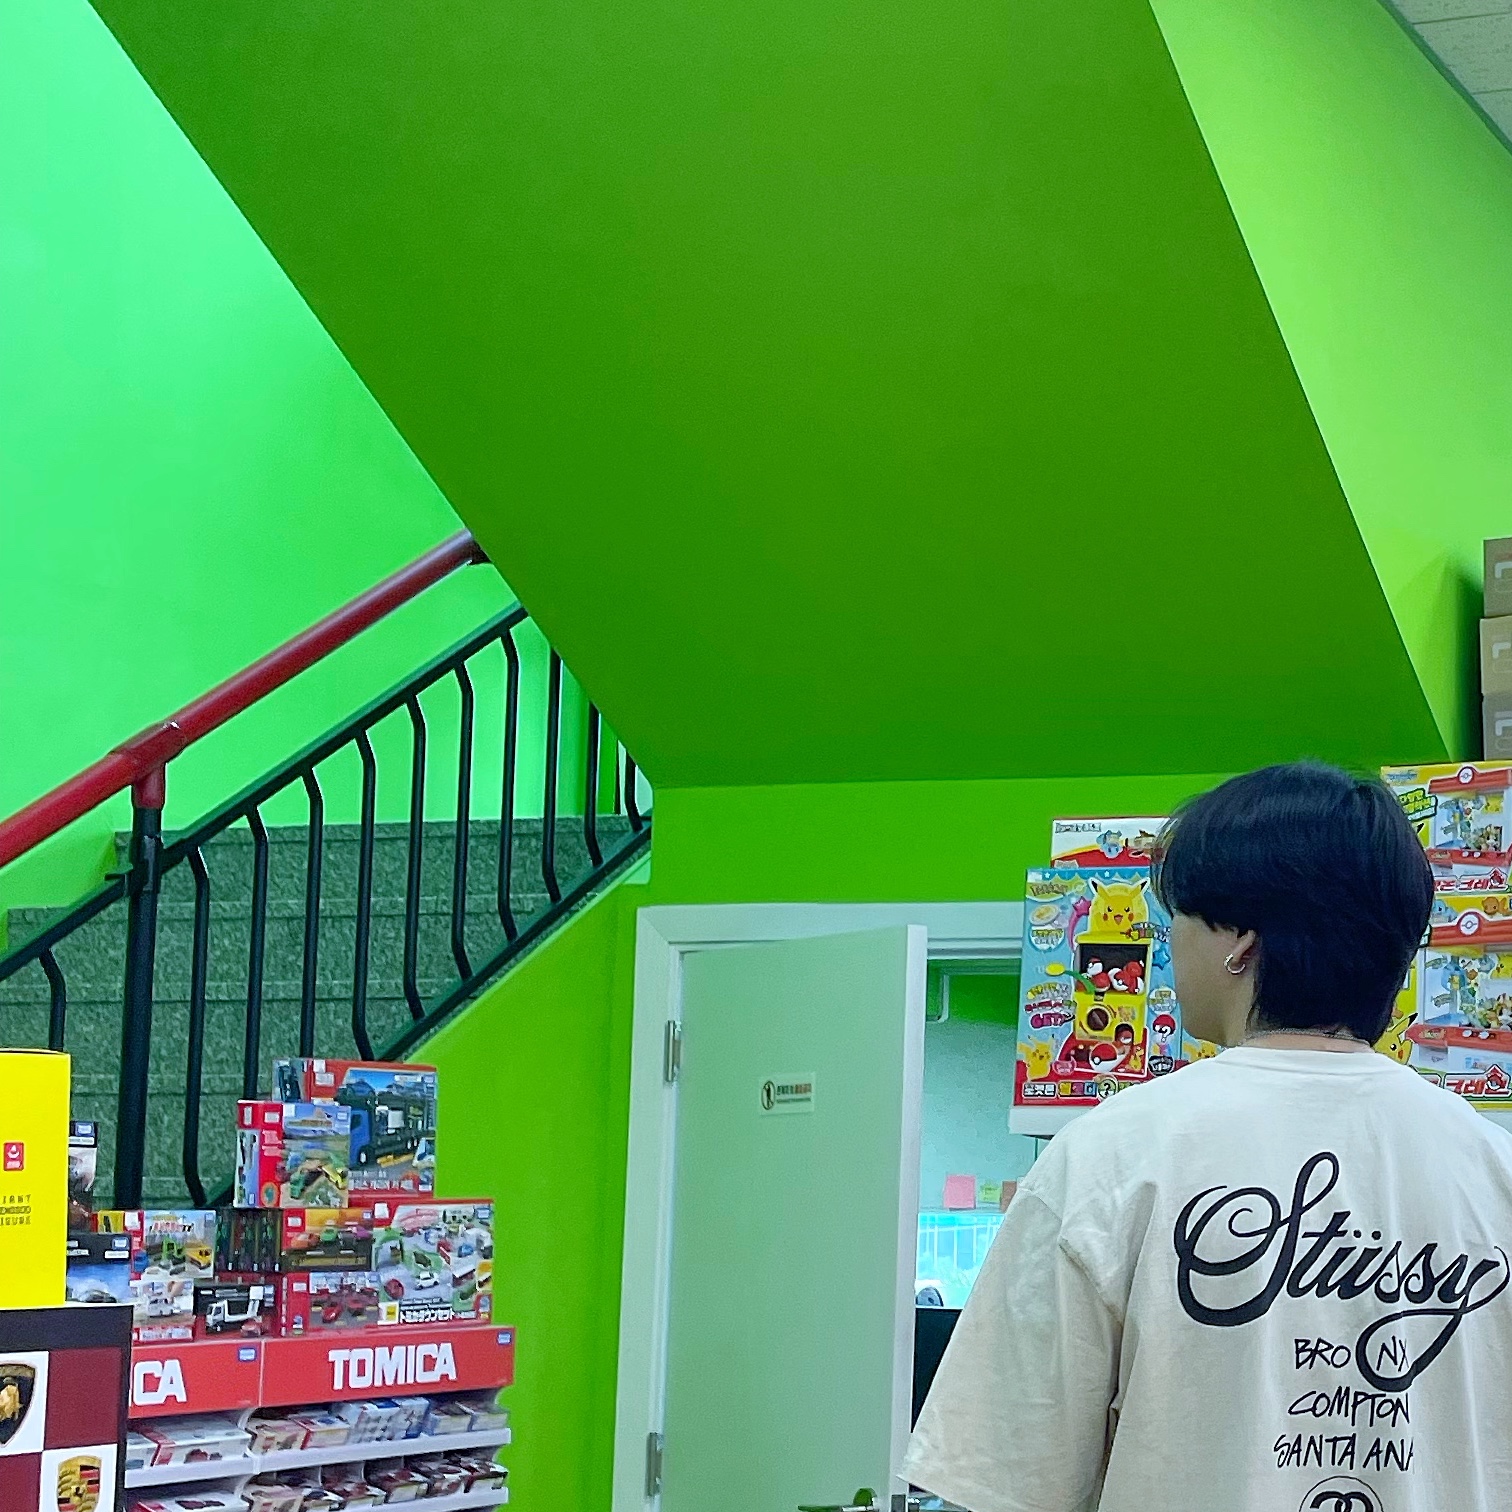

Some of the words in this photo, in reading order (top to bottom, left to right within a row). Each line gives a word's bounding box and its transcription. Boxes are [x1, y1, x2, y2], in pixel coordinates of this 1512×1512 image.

[1174, 1152, 1511, 1392] Stüssy
[328, 1342, 457, 1391] TOMICA
[1287, 1389, 1410, 1425] COMPTON
[1274, 1433, 1356, 1470] SANTA
